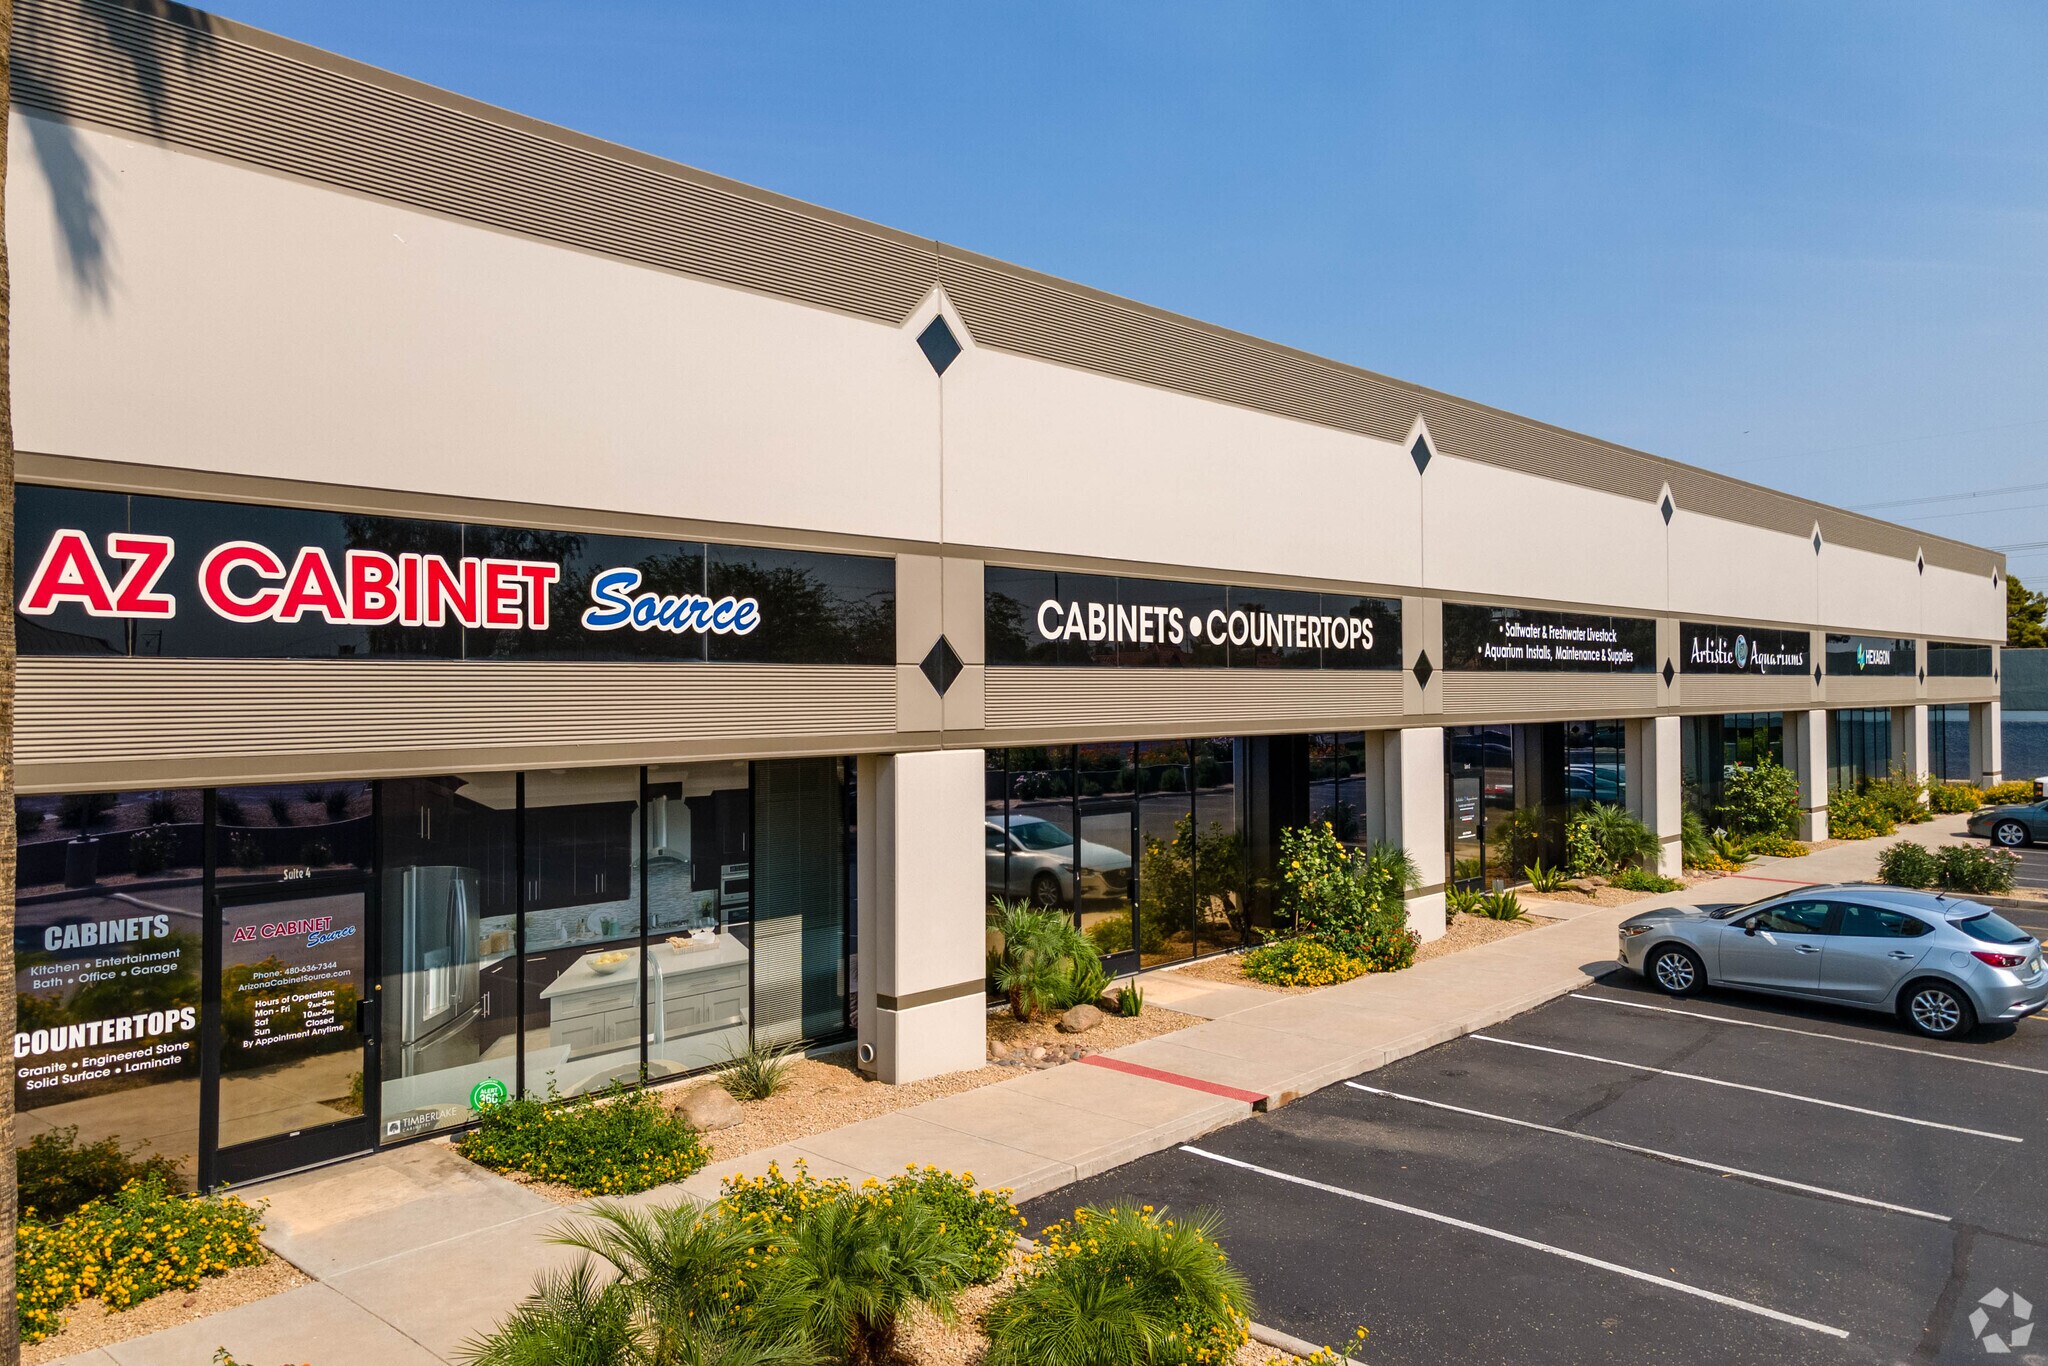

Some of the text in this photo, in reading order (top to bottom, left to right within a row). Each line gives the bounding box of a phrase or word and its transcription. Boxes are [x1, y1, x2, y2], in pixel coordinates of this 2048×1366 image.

[20, 528, 560, 631] AZ CABINET
[582, 567, 761, 635] Source
[1037, 599, 1374, 650] CABINETS COUNTERTOPS
[1505, 622, 1617, 642] Saltwater & Freshwater Livestock
[1484, 642, 1634, 665] Aquarium Installs, Maintenance & Supplies
[1691, 636, 1803, 674] Artistic Aquariums
[1866, 649, 1890, 665] HEXAGON
[283, 867, 311, 880] Suite 4
[44, 914, 169, 951] CABINETS
[232, 916, 332, 943] AZ CABINET
[307, 925, 356, 948] Source
[31, 949, 181, 976] Kitchen Entertainment
[253, 961, 337, 980] Phone: 480-636-7344
[33, 962, 178, 989] Bath Office Garage
[238, 969, 351, 992] ArizonaCabinetSource.com
[255, 989, 335, 1008] Hours of Operation:
[255, 1008, 274, 1018] Mon
[281, 1005, 291, 1013] Fri
[255, 1018, 269, 1027] Sat
[14, 1006, 196, 1058] COUNTERTOPS
[243, 1024, 344, 1049] By Appointment Anytime
[254, 1016, 334, 1036] Sun Closed
[18, 1042, 190, 1078] Granite Engineered Stone
[26, 1054, 182, 1091] Solid Surface Laminate
[403, 1107, 457, 1127] TIMBERLAKE
